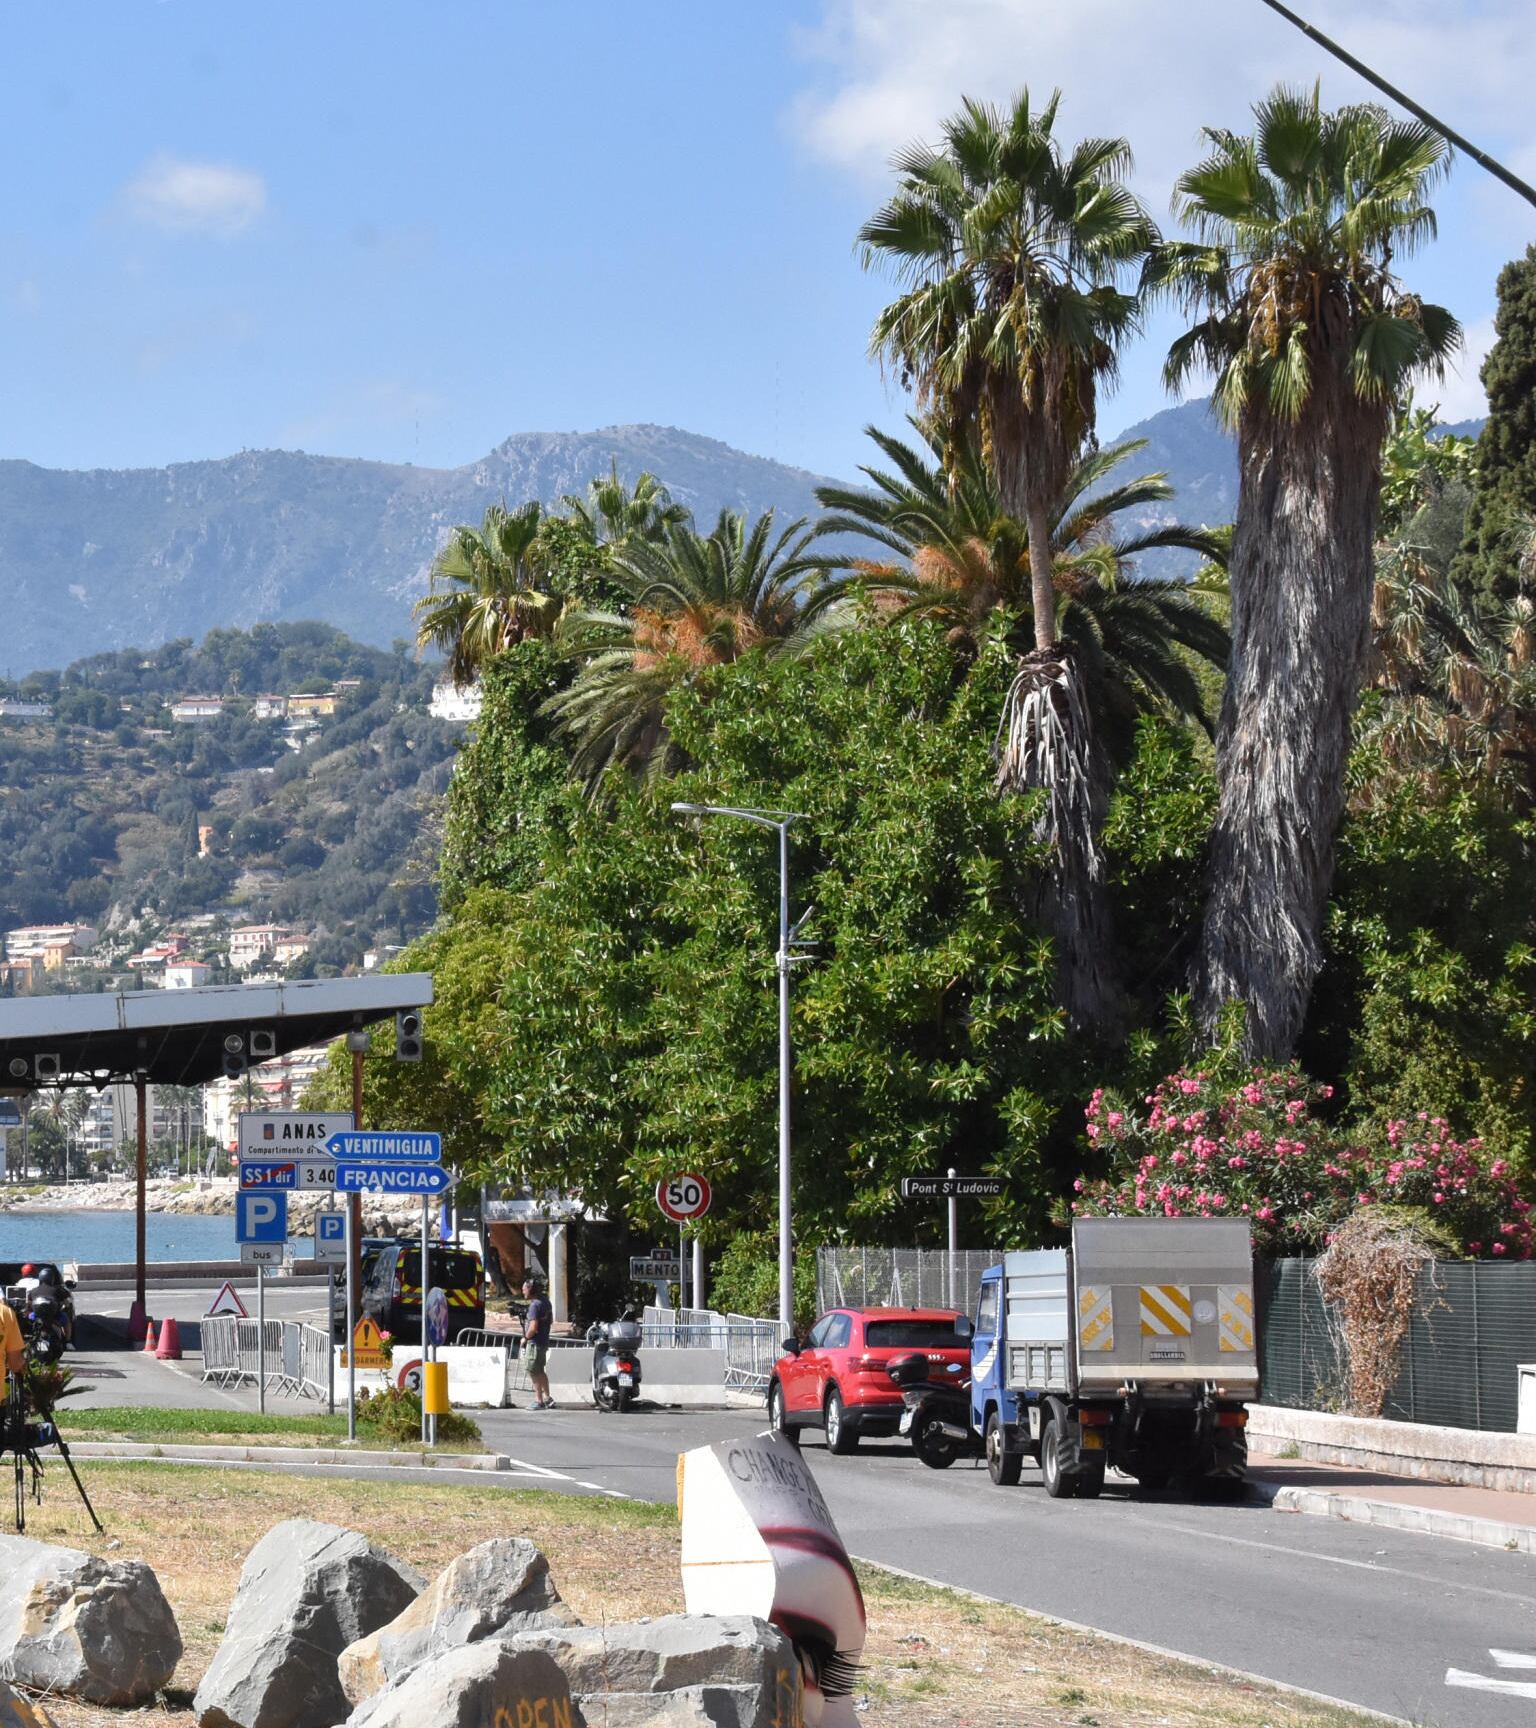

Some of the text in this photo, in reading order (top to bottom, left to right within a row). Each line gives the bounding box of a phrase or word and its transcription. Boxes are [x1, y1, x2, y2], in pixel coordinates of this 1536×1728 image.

[282, 1123, 326, 1139] ANAS
[248, 1145, 304, 1156] Compartimento
[344, 1138, 433, 1156] VENTIMIGLIA
[245, 1168, 263, 1184] SS
[275, 1169, 292, 1184] dir
[344, 1170, 431, 1187] FRANCIA
[669, 1184, 700, 1205] 50
[911, 1182, 1000, 1193] Pont St Ludovic
[246, 1196, 277, 1238] P
[325, 1219, 340, 1237] P
[253, 1250, 271, 1259] bus
[728, 1448, 805, 1492] CHANGE
[494, 1695, 573, 1728] OPEN
